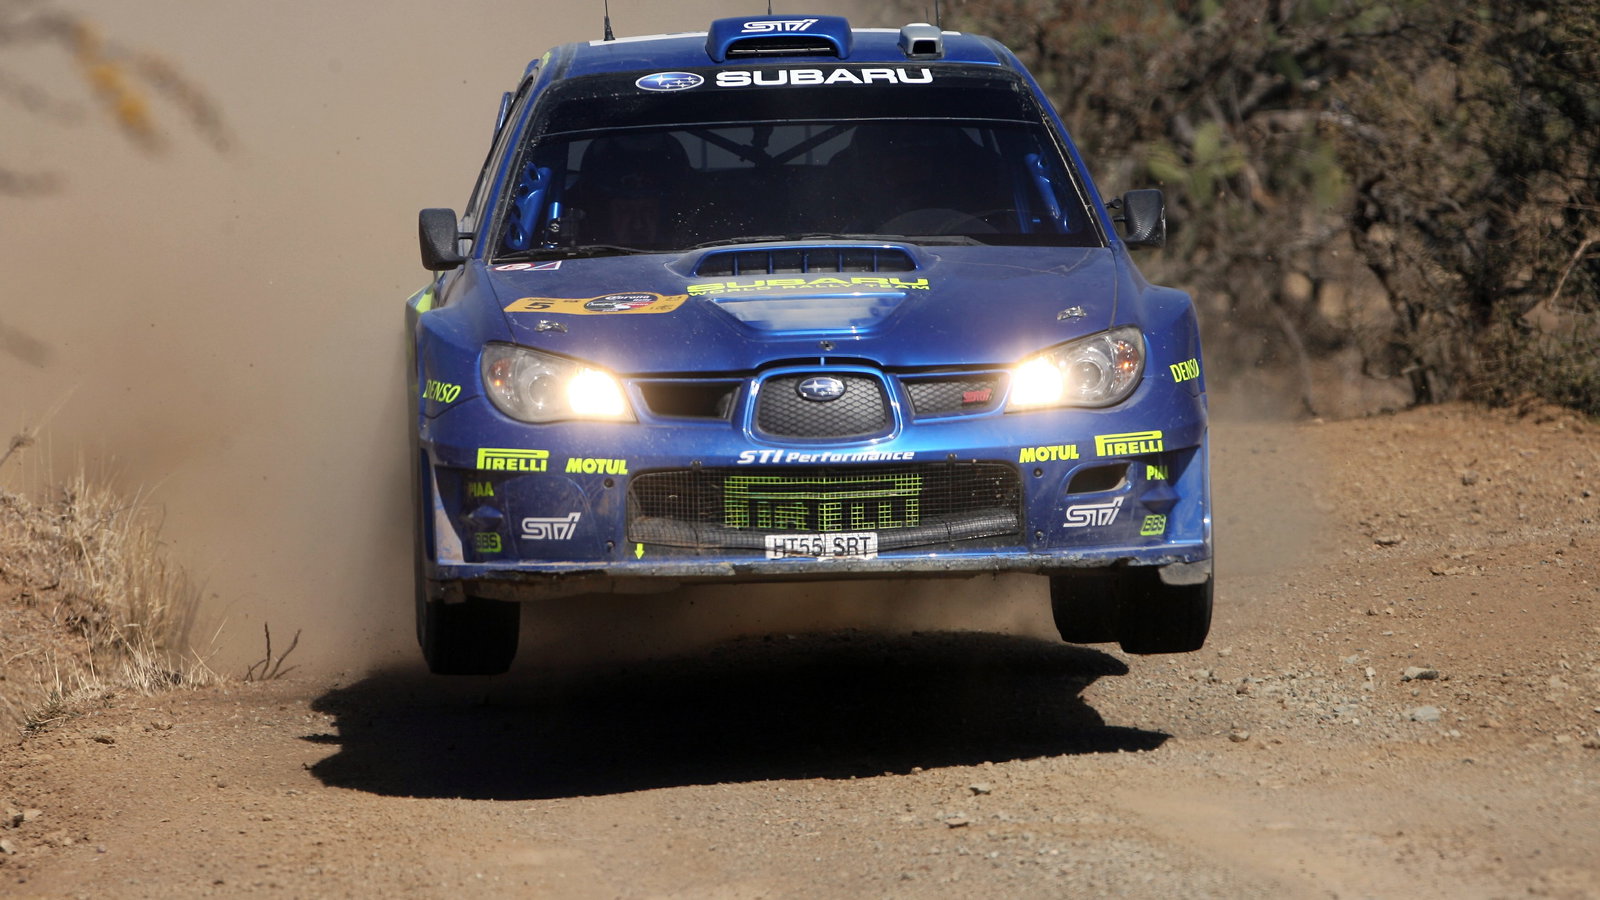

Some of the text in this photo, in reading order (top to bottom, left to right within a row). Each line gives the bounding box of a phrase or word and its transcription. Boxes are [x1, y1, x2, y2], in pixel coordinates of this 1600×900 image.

[716, 68, 933, 86] SUBARU
[687, 277, 929, 292] SUBARU
[688, 286, 770, 297] WORLD
[1169, 358, 1200, 383] DENSO
[423, 379, 462, 404] DENSO
[1094, 430, 1163, 457] PIRELLI
[476, 447, 550, 472] PIRELLI
[736, 450, 915, 465] STI Performance
[1019, 444, 1080, 464] MOTUL
[565, 457, 628, 475] MOTUL
[832, 537, 873, 555] SRT
